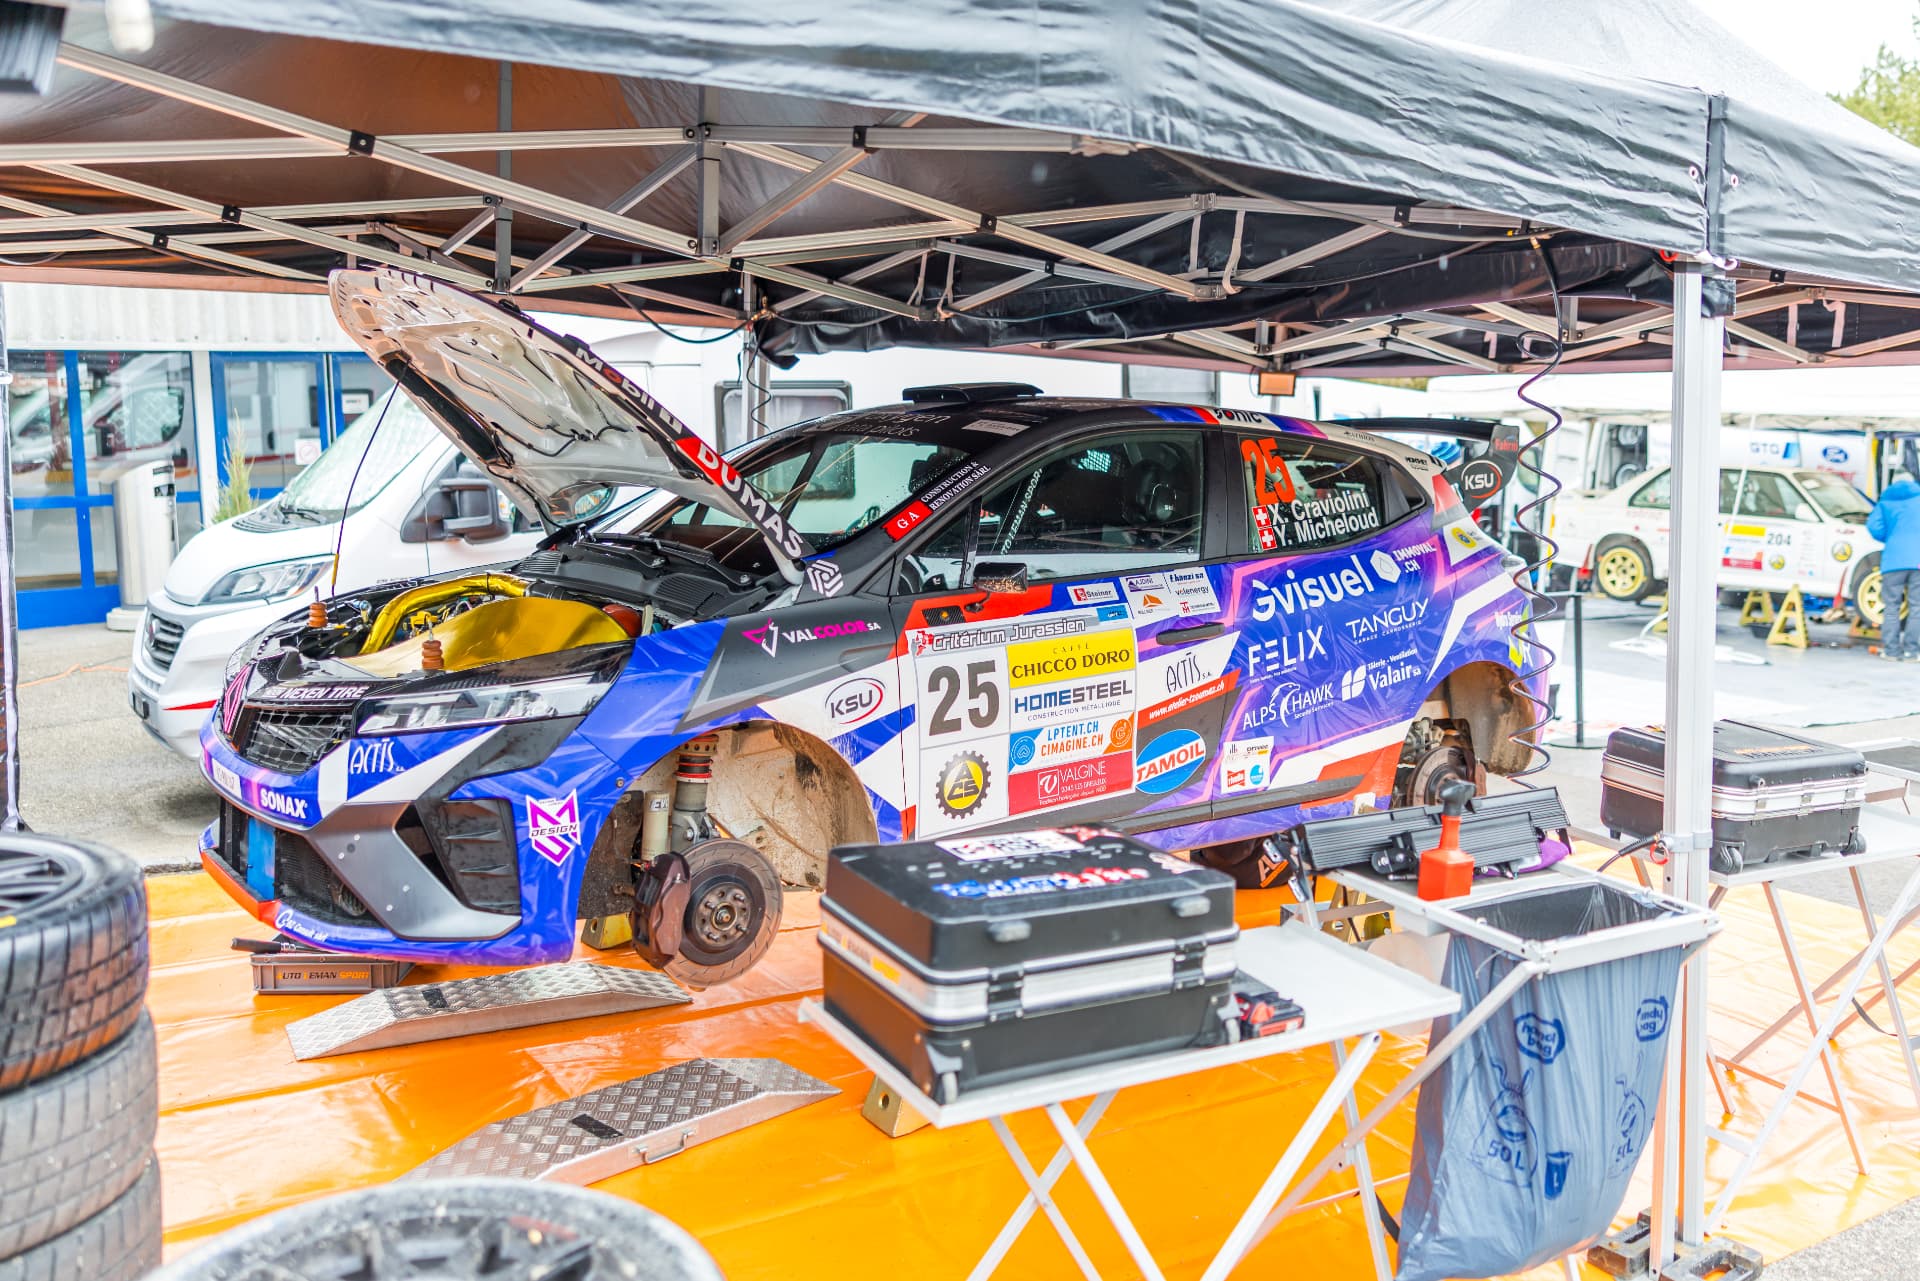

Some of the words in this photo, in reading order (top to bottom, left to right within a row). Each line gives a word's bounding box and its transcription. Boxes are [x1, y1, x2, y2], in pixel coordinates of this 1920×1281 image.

[576, 348, 655, 410] Mobil
[921, 463, 973, 503] CONSTRUCTION
[1241, 438, 1296, 504] 25
[1465, 473, 1494, 490] KSU
[697, 444, 802, 559] DUMAS
[929, 475, 972, 511] RENOVATION
[1268, 503, 1289, 525] X.
[1291, 488, 1370, 519] Craviolini
[1275, 525, 1293, 548] Y.
[1294, 507, 1379, 542] Micheloud
[1767, 532, 1792, 547] 204
[1394, 543, 1437, 561] IMMOVAL
[1252, 555, 1374, 622] Gvisuel
[782, 620, 869, 643] VALCOLOR
[1345, 597, 1429, 638] TANGUY
[932, 629, 1006, 651] Critérium
[1010, 618, 1085, 640] Jurassien
[1012, 657, 1077, 678] CHICCO
[1082, 649, 1130, 668] D'ORO
[1248, 625, 1326, 677] FELIX
[1369, 662, 1412, 690] Valair
[280, 687, 330, 699] NEXEN
[328, 686, 370, 699] TIRE
[831, 689, 873, 718] KSU
[927, 660, 1000, 736] 25
[1015, 680, 1132, 713] HOMESTEEL
[1243, 703, 1277, 731] ALPS
[1292, 683, 1334, 712] HAWK
[1027, 707, 1079, 721] CONSTRUCTION
[1041, 734, 1104, 757] CIMAGINE.CH
[1048, 720, 1099, 741] LPTENT.CH
[1059, 760, 1107, 783] VALGINE
[1137, 742, 1204, 783] TAMOIL
[259, 788, 307, 819] SONAX
[531, 823, 578, 837] DESIGN
[276, 971, 302, 980] AUTO
[303, 971, 337, 980] LEMAN
[339, 971, 369, 980] SPORT
[1488, 1140, 1511, 1162] 50
